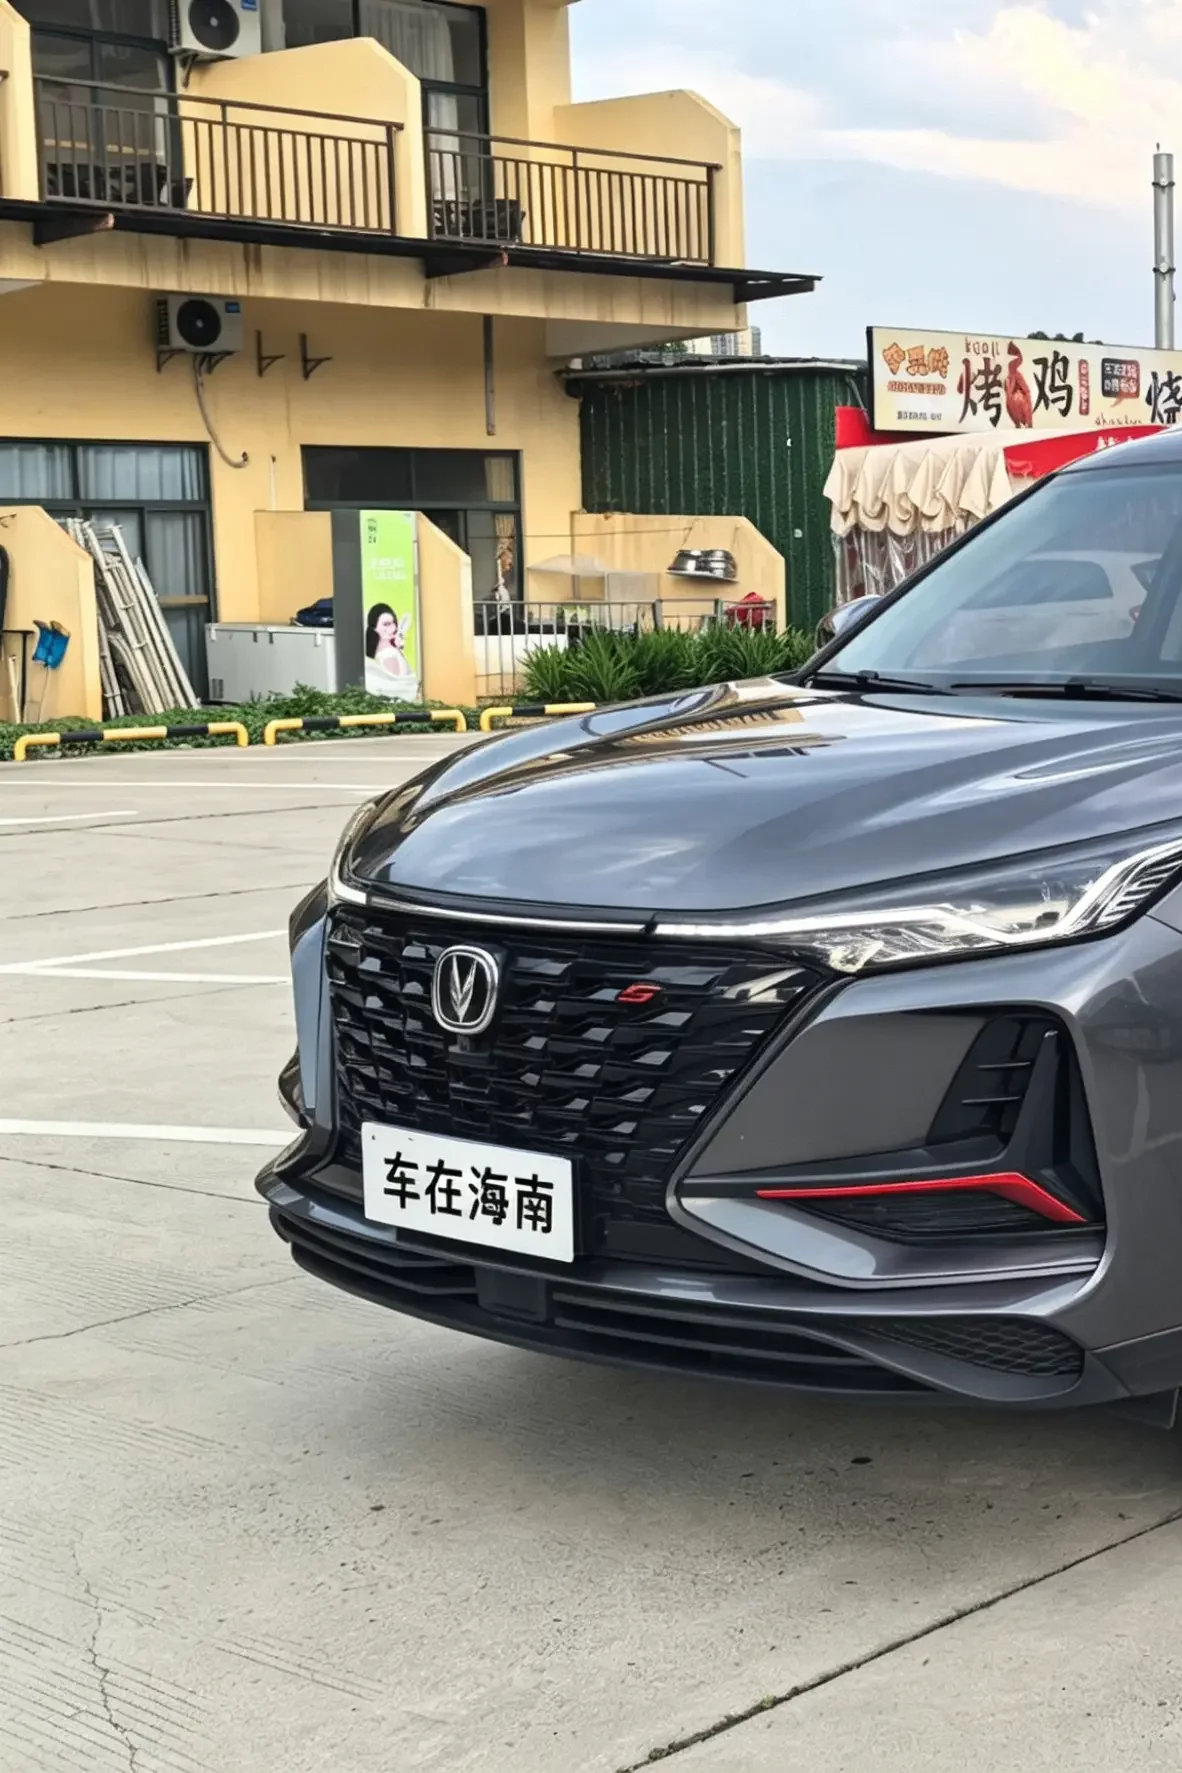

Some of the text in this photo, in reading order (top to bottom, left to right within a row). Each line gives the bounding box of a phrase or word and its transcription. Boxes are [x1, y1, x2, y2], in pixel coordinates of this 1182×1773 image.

[957, 350, 1073, 428] 烤鸡
[383, 1151, 554, 1234] 车在海南
